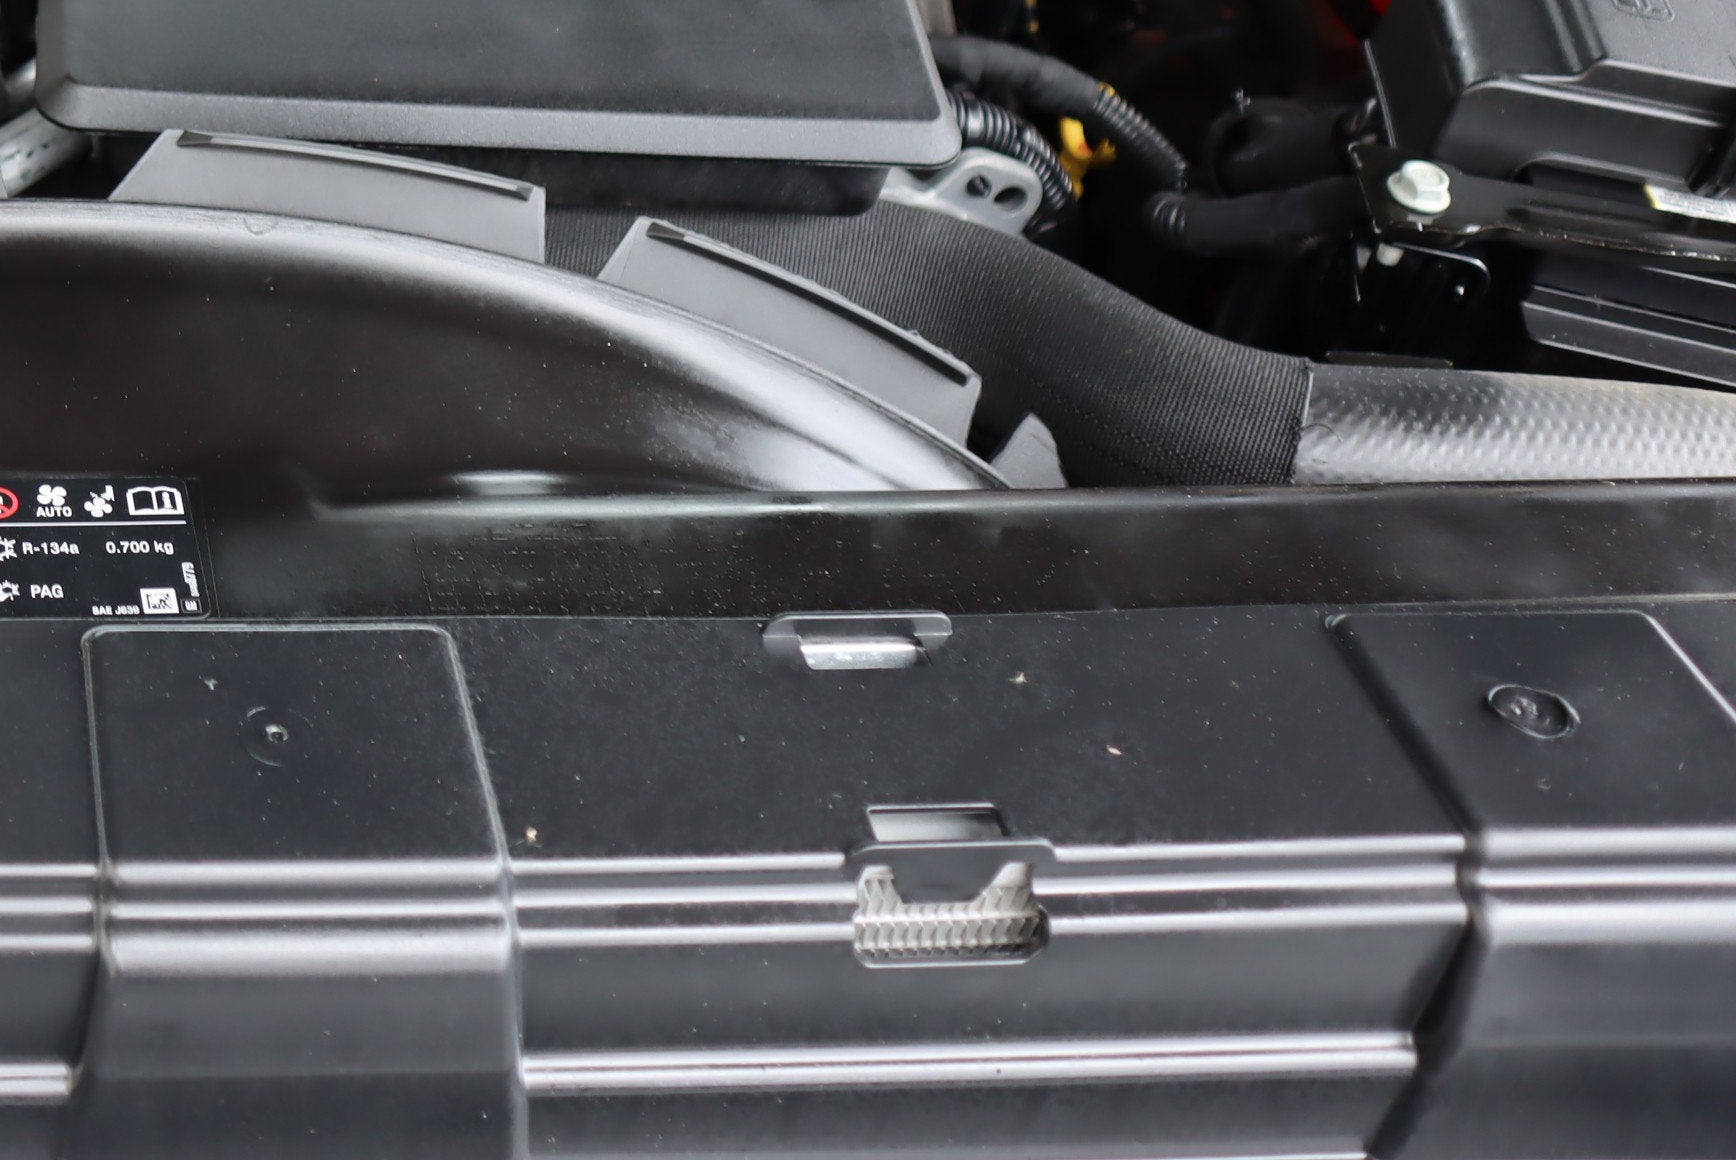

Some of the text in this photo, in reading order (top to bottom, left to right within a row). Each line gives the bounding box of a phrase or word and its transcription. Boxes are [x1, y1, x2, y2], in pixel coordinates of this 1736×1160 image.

[36, 505, 72, 517] AUTO
[22, 541, 175, 555] R-134a 0.700 kg
[30, 584, 64, 599] PAG
